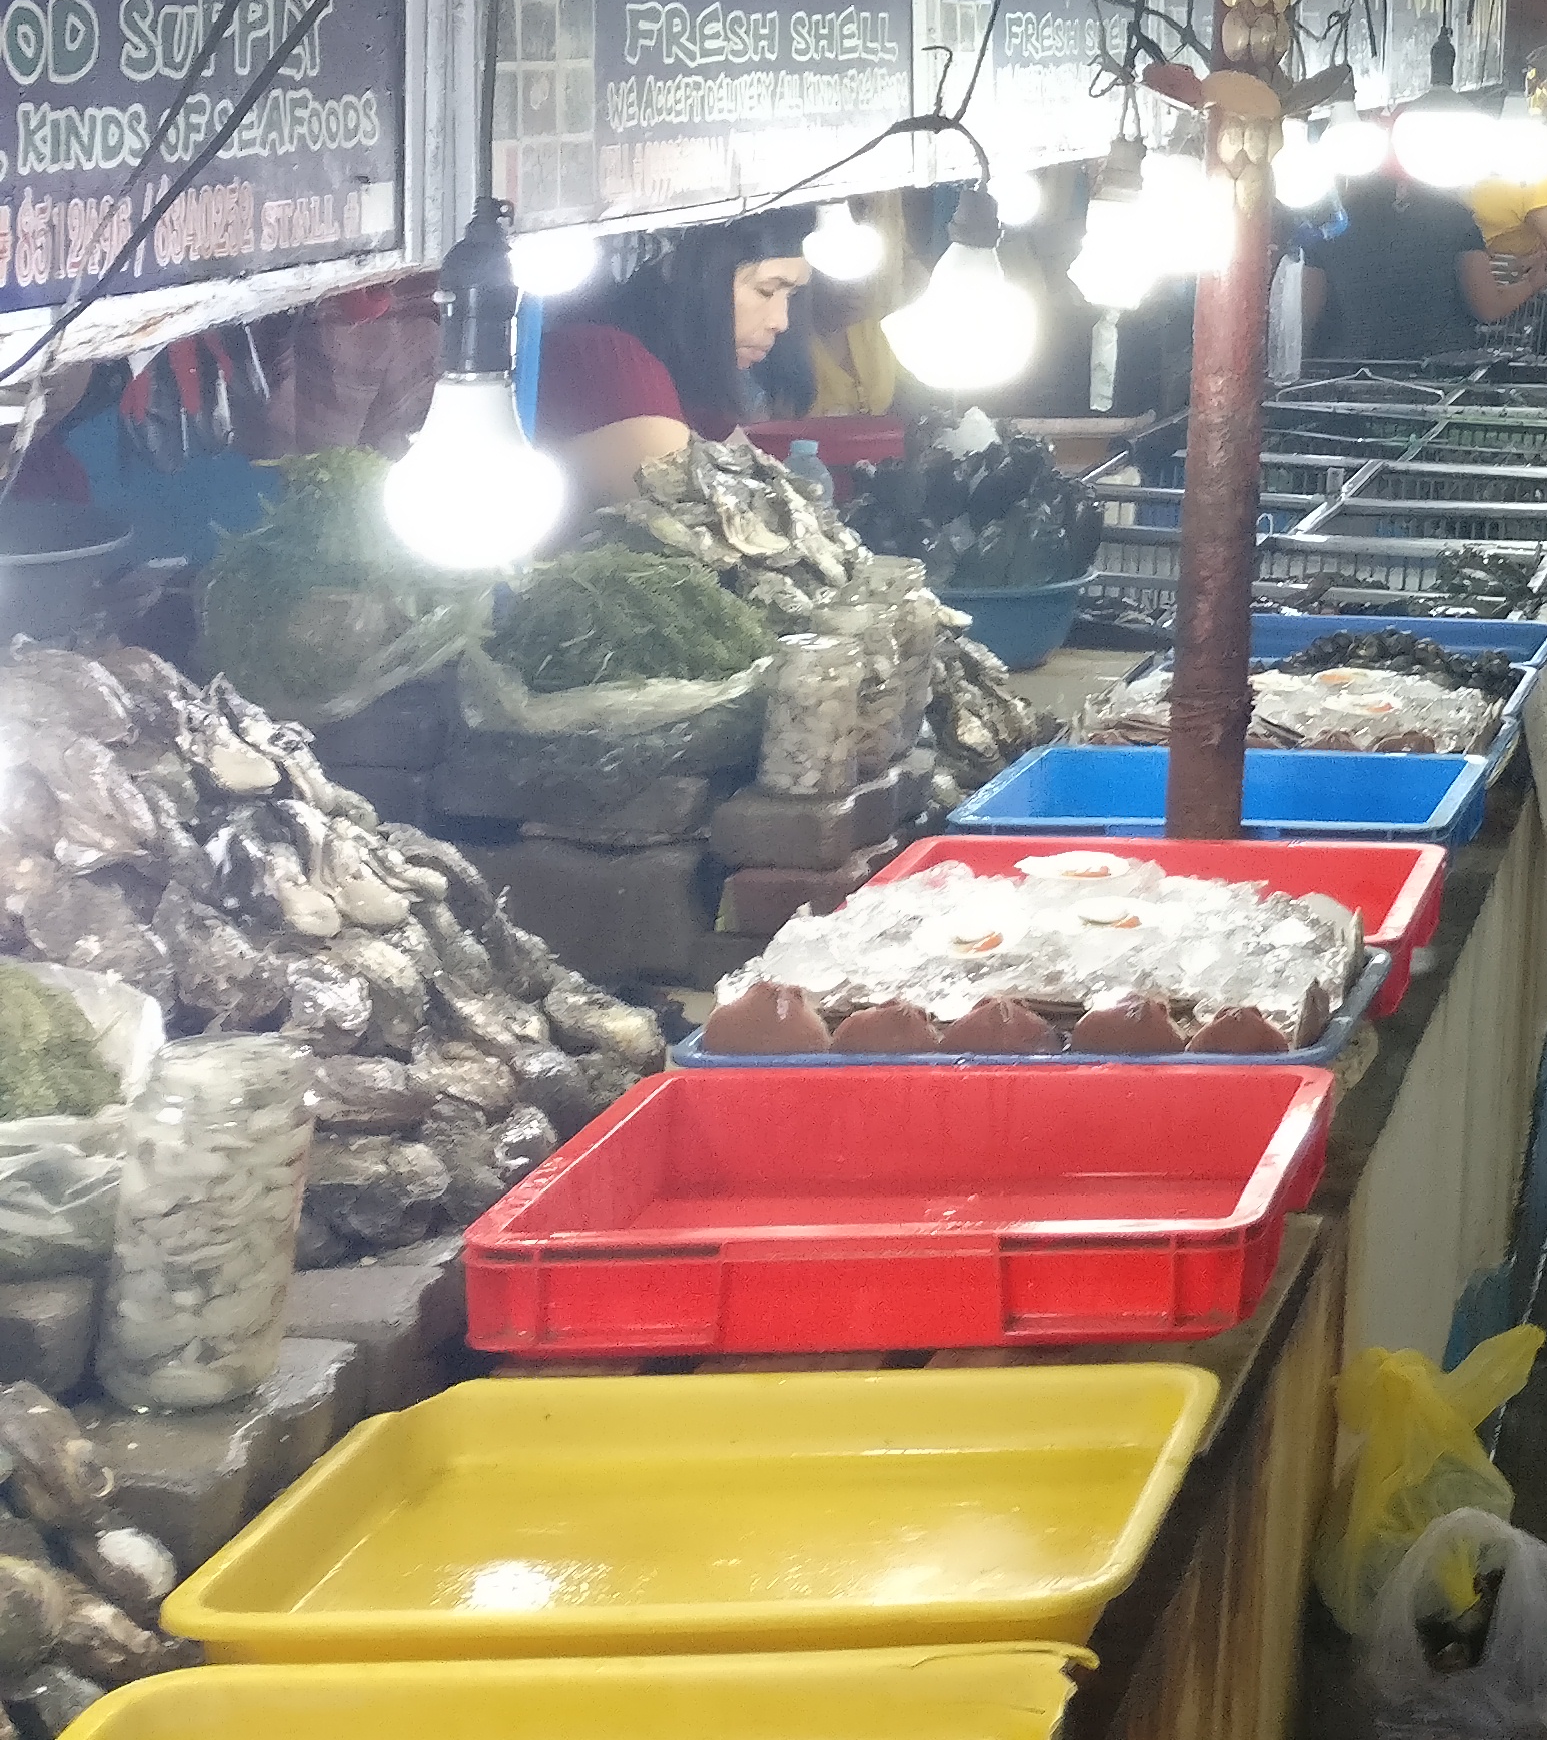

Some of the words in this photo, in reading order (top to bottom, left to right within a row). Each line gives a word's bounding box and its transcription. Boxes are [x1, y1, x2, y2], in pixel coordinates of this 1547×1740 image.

[625, 1, 779, 68] FRESH
[790, 4, 898, 64] SHELL
[1004, 11, 1080, 59] FRESH
[17, 102, 150, 175] KINDS
[213, 86, 381, 159] SEAFOODS
[640, 74, 704, 129] ACCEPT
